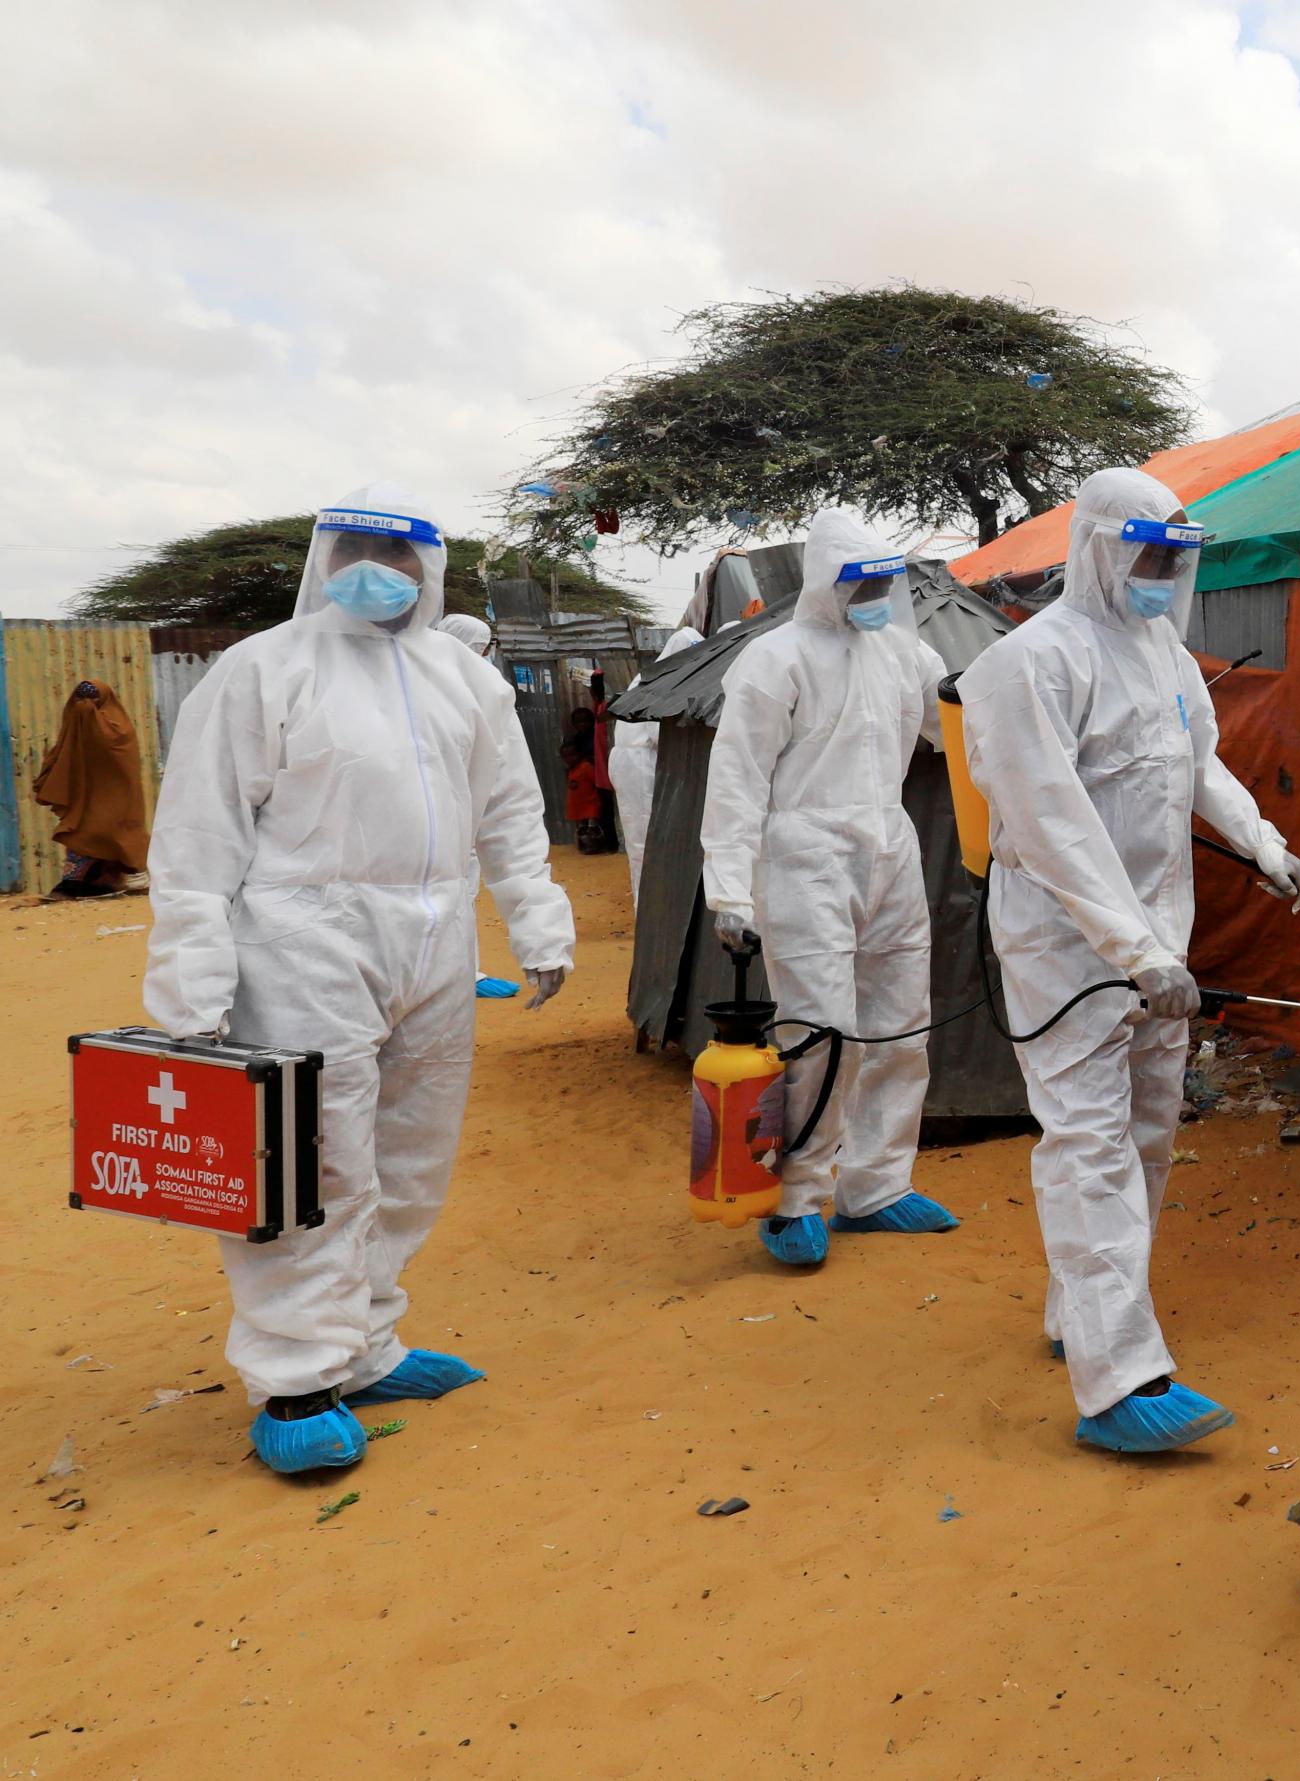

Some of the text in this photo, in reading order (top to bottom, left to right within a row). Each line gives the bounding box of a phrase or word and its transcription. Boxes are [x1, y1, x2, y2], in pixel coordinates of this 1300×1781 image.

[323, 513, 393, 528] Face Shield
[1180, 530, 1198, 540] Face
[112, 1123, 158, 1148] FIRST
[162, 1132, 191, 1154] AID
[155, 1163, 244, 1191] SOMALI FIRST AID
[154, 1180, 248, 1208] ASSOCIATION (SOFA)
